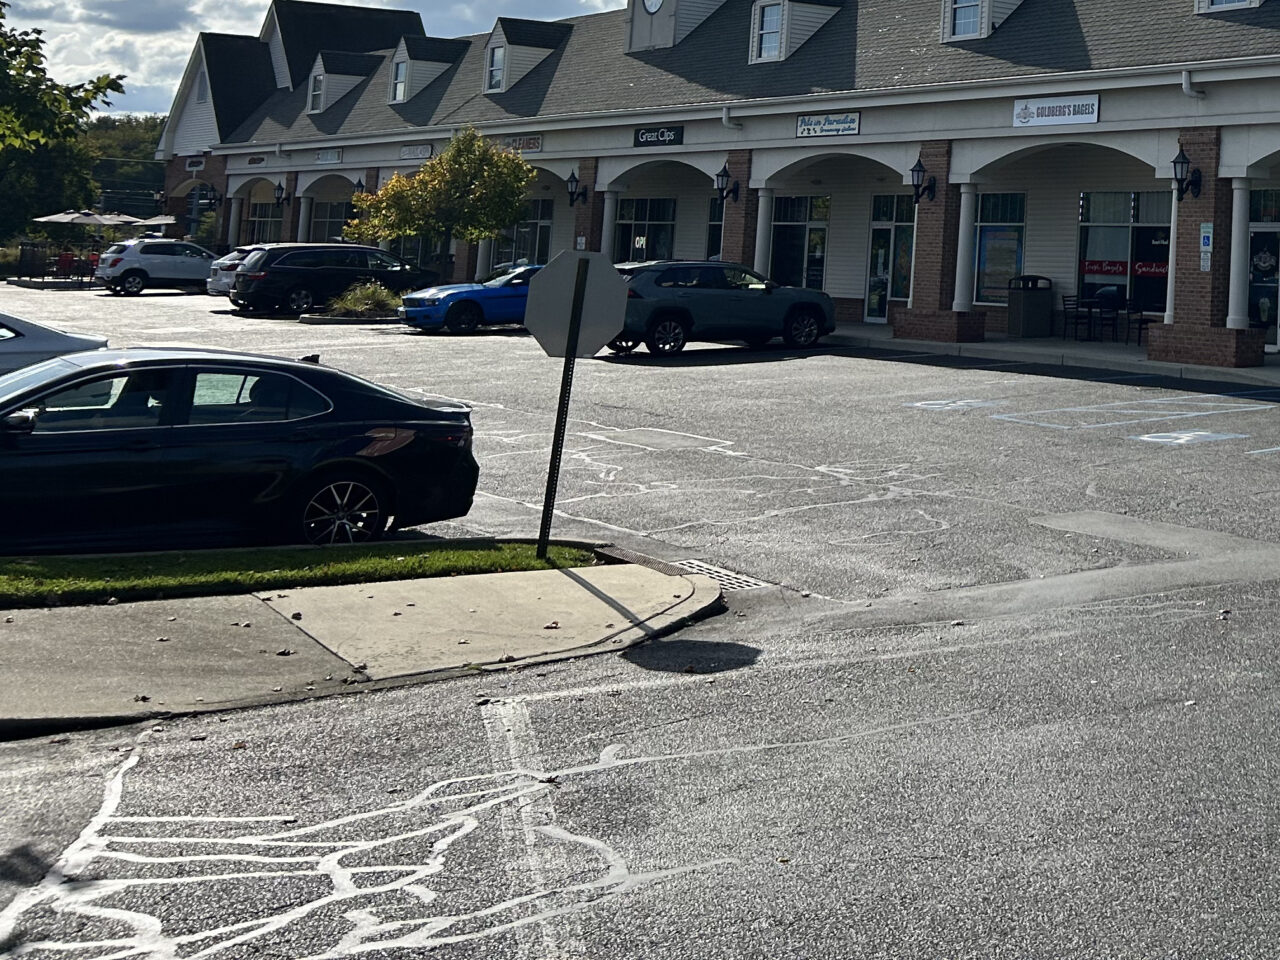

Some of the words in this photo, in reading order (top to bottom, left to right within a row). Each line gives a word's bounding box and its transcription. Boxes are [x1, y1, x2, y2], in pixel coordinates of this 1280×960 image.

[1036, 105, 1072, 118] GOLDBERG'S
[1073, 103, 1095, 116] BAGELS
[823, 115, 856, 126] Paradise
[639, 130, 658, 141] Great
[658, 129, 674, 143] Clips
